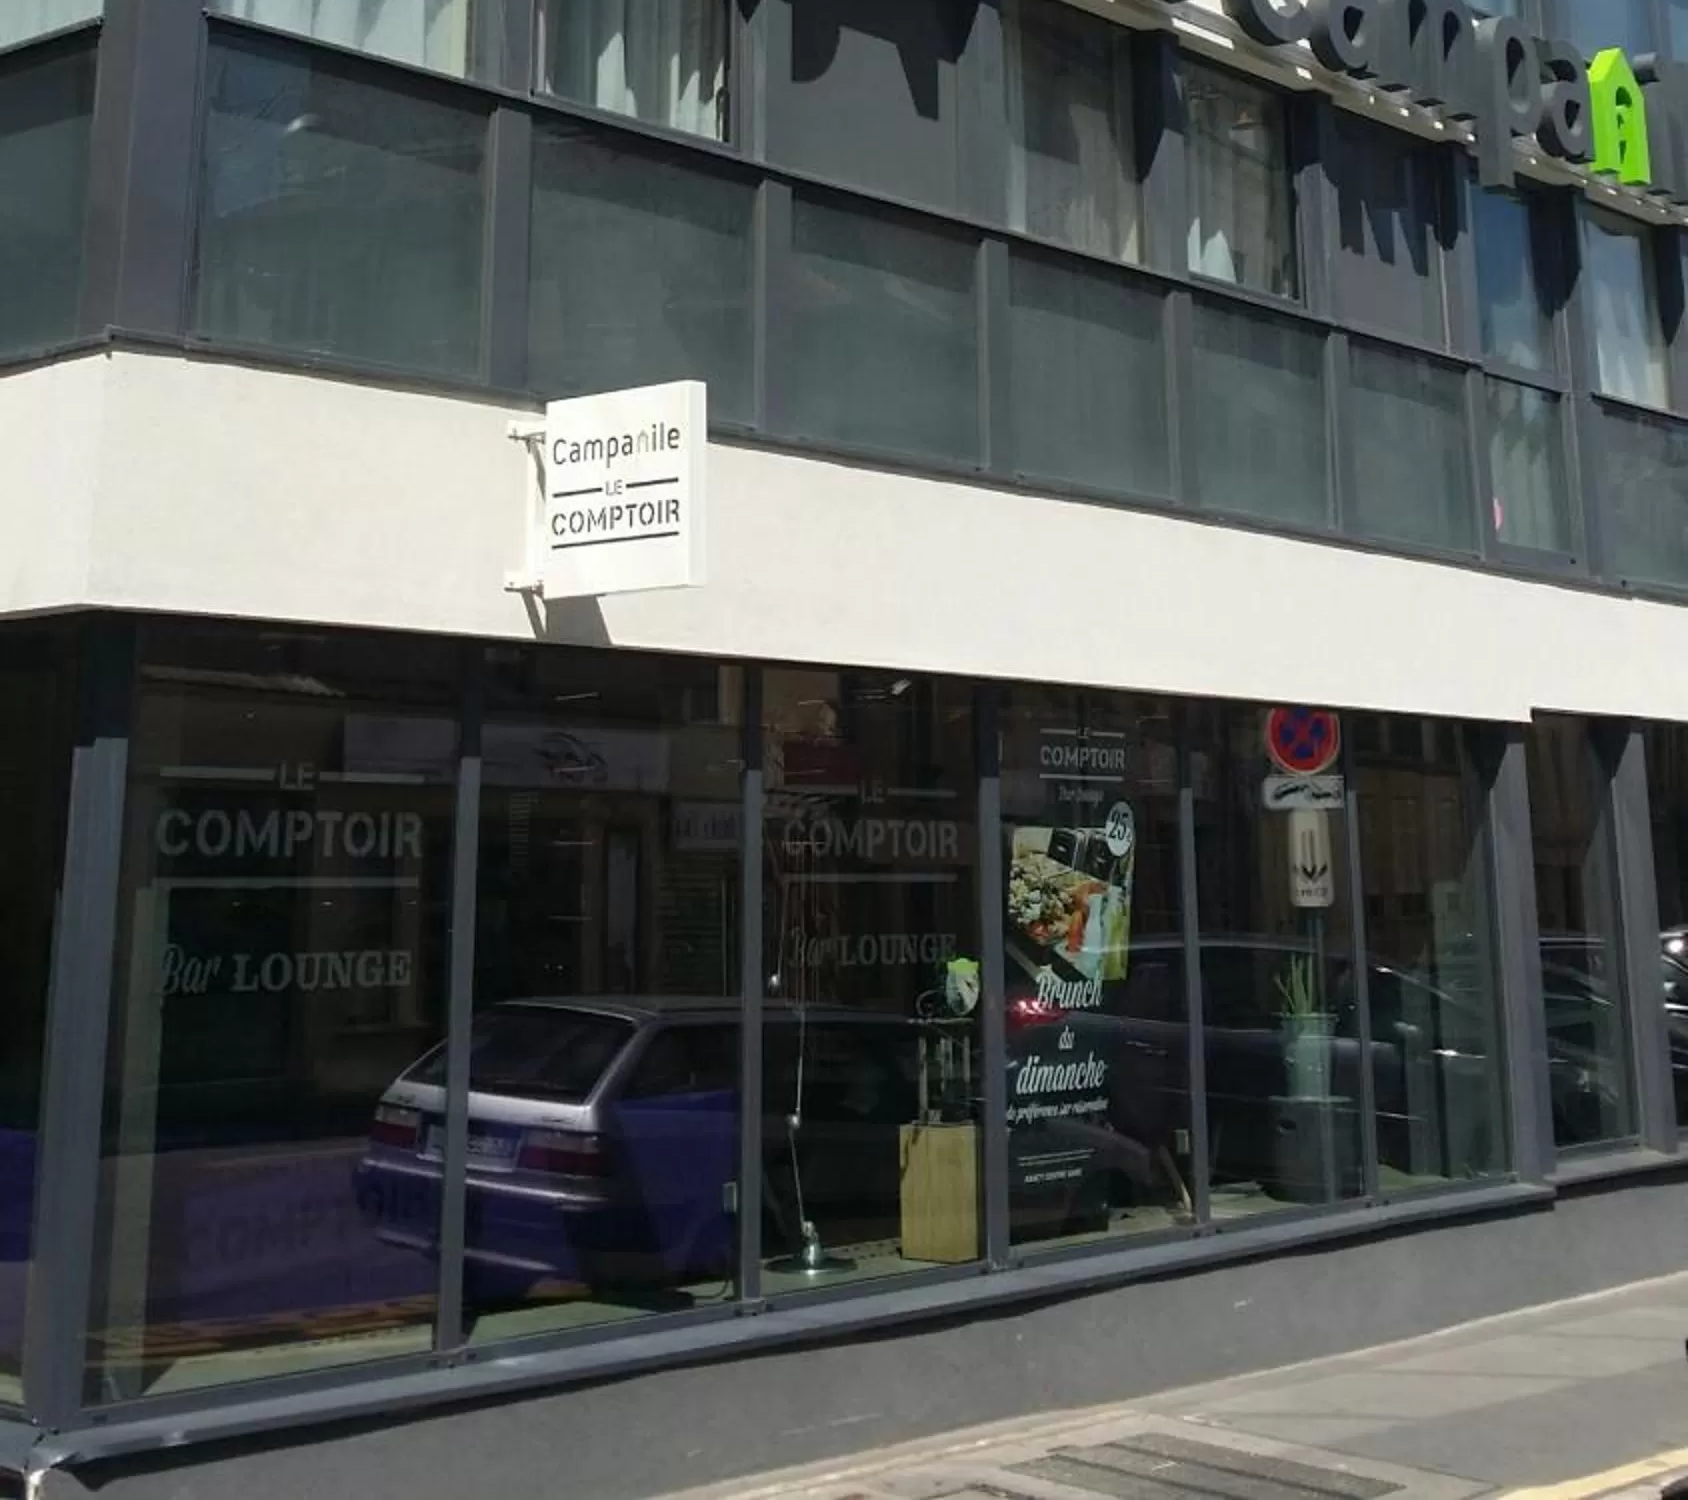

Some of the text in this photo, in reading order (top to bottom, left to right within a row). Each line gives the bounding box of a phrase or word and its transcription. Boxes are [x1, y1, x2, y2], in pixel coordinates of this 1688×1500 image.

[553, 421, 681, 468] Campanile
[605, 479, 623, 496] LE
[551, 498, 680, 536] COMPTOIR
[279, 759, 317, 791] LE
[1040, 745, 1125, 771] COMPTOIR
[860, 778, 886, 805] LE
[155, 808, 423, 858] COMPTOIR
[783, 818, 959, 860] COMPTOIR
[838, 932, 957, 966] LOUNGE
[157, 943, 413, 997] Bar LOUNGE
[1036, 963, 1104, 1010] Brunch
[1016, 1051, 1107, 1096] dimanche
